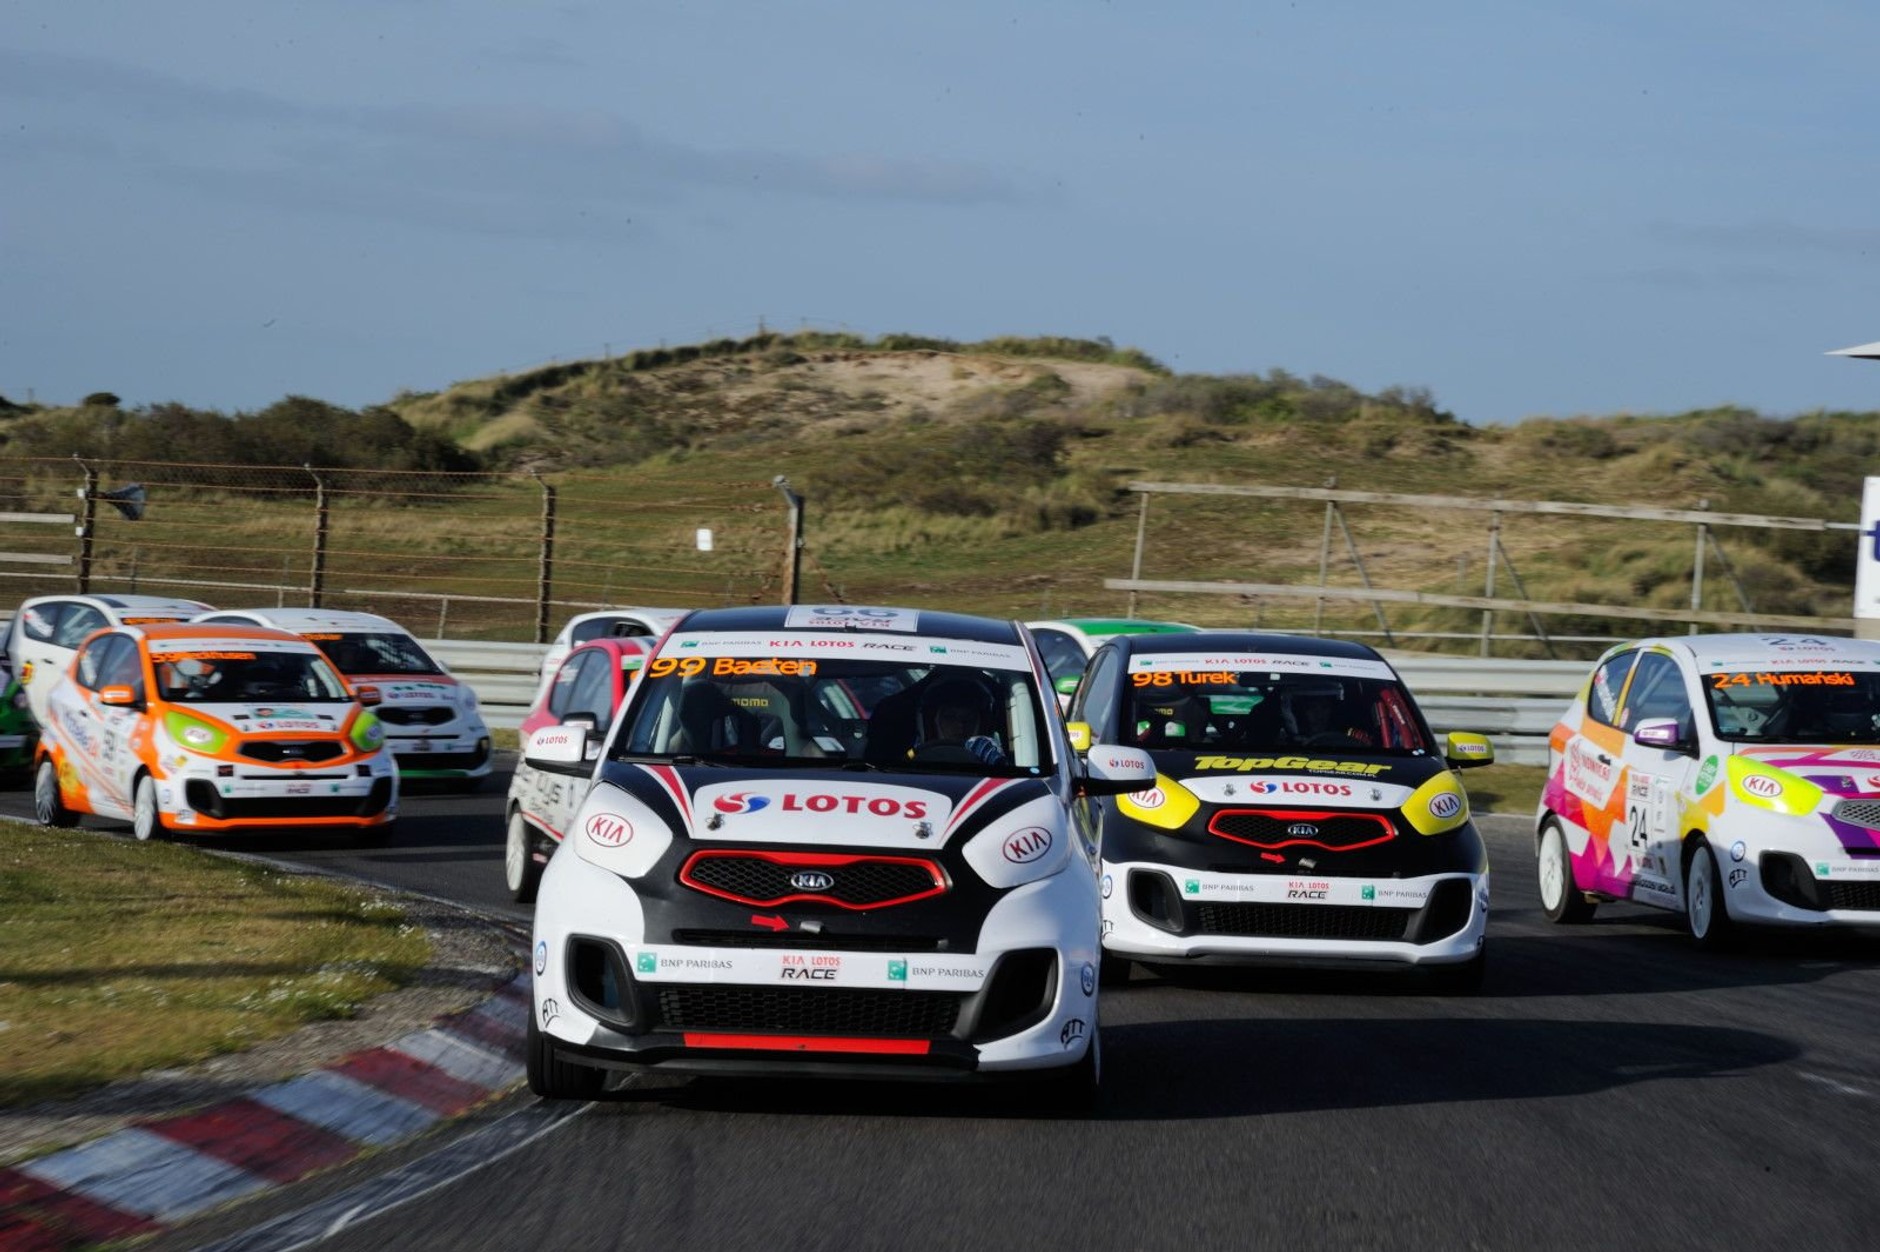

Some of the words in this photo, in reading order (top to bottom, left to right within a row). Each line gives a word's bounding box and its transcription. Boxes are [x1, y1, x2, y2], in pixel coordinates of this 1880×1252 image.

[769, 640, 803, 648] KIA
[810, 640, 855, 648] LOTOS
[862, 642, 919, 652] RACE
[650, 656, 707, 679] 99
[713, 656, 818, 677] Baeten
[1204, 658, 1230, 666] KIA
[1133, 672, 1174, 687] 98
[1178, 670, 1238, 686] Turek
[1711, 673, 1752, 689] 24
[1755, 671, 1856, 687] Humański
[545, 735, 568, 745] LOTOS
[1120, 762, 1145, 770] LOTOS
[1194, 755, 1393, 776] TopGear
[1282, 781, 1352, 797] LOTOS
[1749, 777, 1776, 795] KIA
[781, 793, 927, 820] LOTOS
[1434, 796, 1458, 815] KIA
[590, 816, 625, 845] KIA
[1291, 825, 1313, 836] KIA
[1629, 805, 1648, 849] 24
[1008, 830, 1049, 860] KIA
[798, 876, 826, 889] KIA
[1221, 884, 1255, 892] PARIBAS
[1288, 881, 1304, 889] KIA
[1308, 882, 1330, 890] LOTOS
[1287, 890, 1328, 900] RACE
[1378, 889, 1394, 897] BNP
[1396, 891, 1428, 899] PARIBAS
[660, 958, 683, 969] BNP
[685, 959, 734, 970] PARIBAS
[782, 955, 805, 966] KIA
[810, 955, 841, 967] LOTOS
[780, 968, 837, 981] RACE
[912, 967, 936, 977] BNP
[938, 967, 985, 978] PARIBAS
